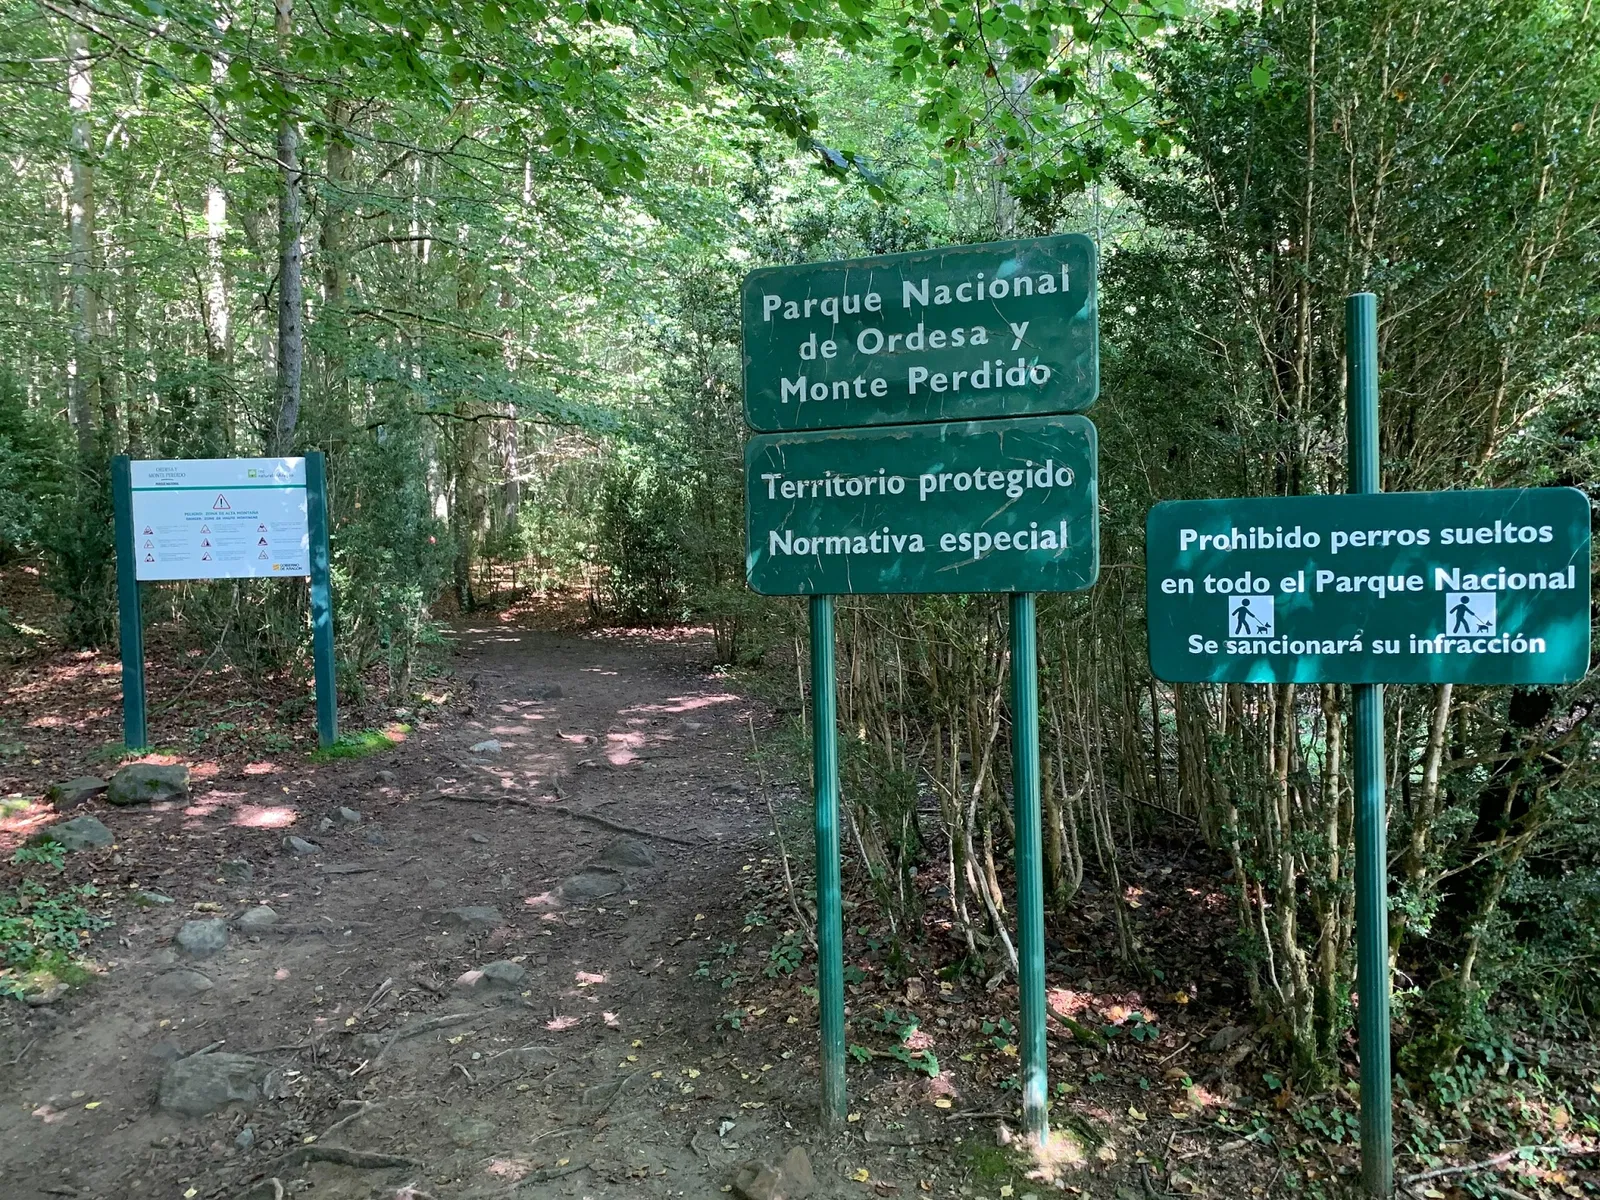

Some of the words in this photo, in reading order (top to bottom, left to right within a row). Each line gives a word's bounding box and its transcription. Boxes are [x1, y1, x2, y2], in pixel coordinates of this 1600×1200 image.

[763, 291, 882, 323] Parque
[903, 264, 1069, 309] Nacional
[800, 333, 838, 360] de
[857, 323, 989, 355] Ordesa
[1010, 321, 1030, 351] y
[781, 376, 888, 403] Monte
[908, 357, 1051, 395] Perdido
[761, 467, 905, 500] Territorio
[919, 459, 1075, 501] protegido
[769, 526, 925, 556] Normativa
[940, 520, 1068, 560] especial
[1179, 525, 1321, 551] Prohibido
[1330, 528, 1431, 554] perros
[1440, 520, 1554, 545] sueltos
[1161, 577, 1194, 594] en
[1203, 571, 1271, 593] todo
[1280, 570, 1305, 593] el
[1316, 569, 1424, 599] Parque
[1434, 565, 1576, 591] Nacional
[1188, 634, 1219, 654] Se
[1226, 634, 1363, 655] sancionará
[1372, 638, 1401, 654] su
[1409, 632, 1546, 654] infracción
